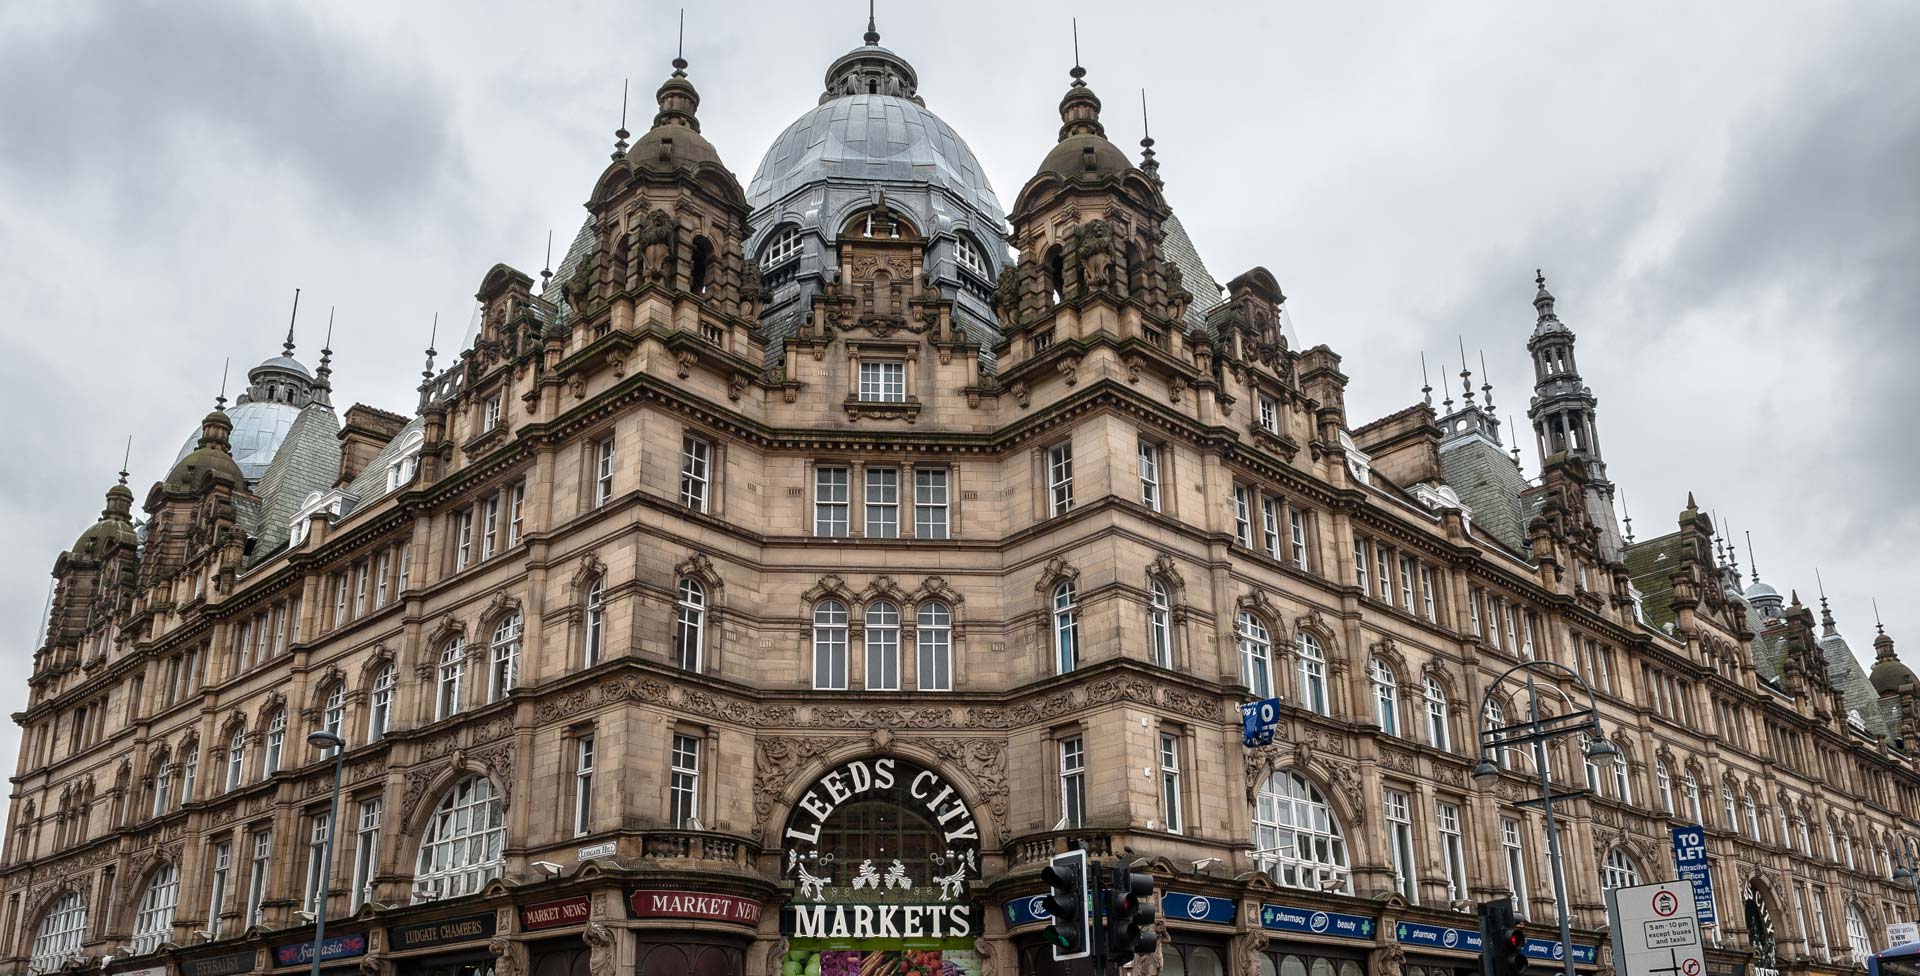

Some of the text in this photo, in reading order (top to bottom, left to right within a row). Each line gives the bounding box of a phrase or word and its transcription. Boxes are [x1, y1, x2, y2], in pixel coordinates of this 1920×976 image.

[786, 758, 978, 845] LEEDS CITY
[1679, 833, 1699, 847] TO
[1677, 846, 1705, 861] LET
[1680, 864, 1708, 873] Attractive
[527, 903, 587, 924] MARKET NEWS
[651, 895, 732, 916] MARKET
[793, 904, 970, 939] MARKETS
[1275, 911, 1306, 926] pharmacy
[1336, 919, 1356, 932] beauty
[404, 920, 483, 945] LUDGATE CHAMBERS
[1412, 929, 1437, 942] pharmacy
[1656, 937, 1669, 945] and
